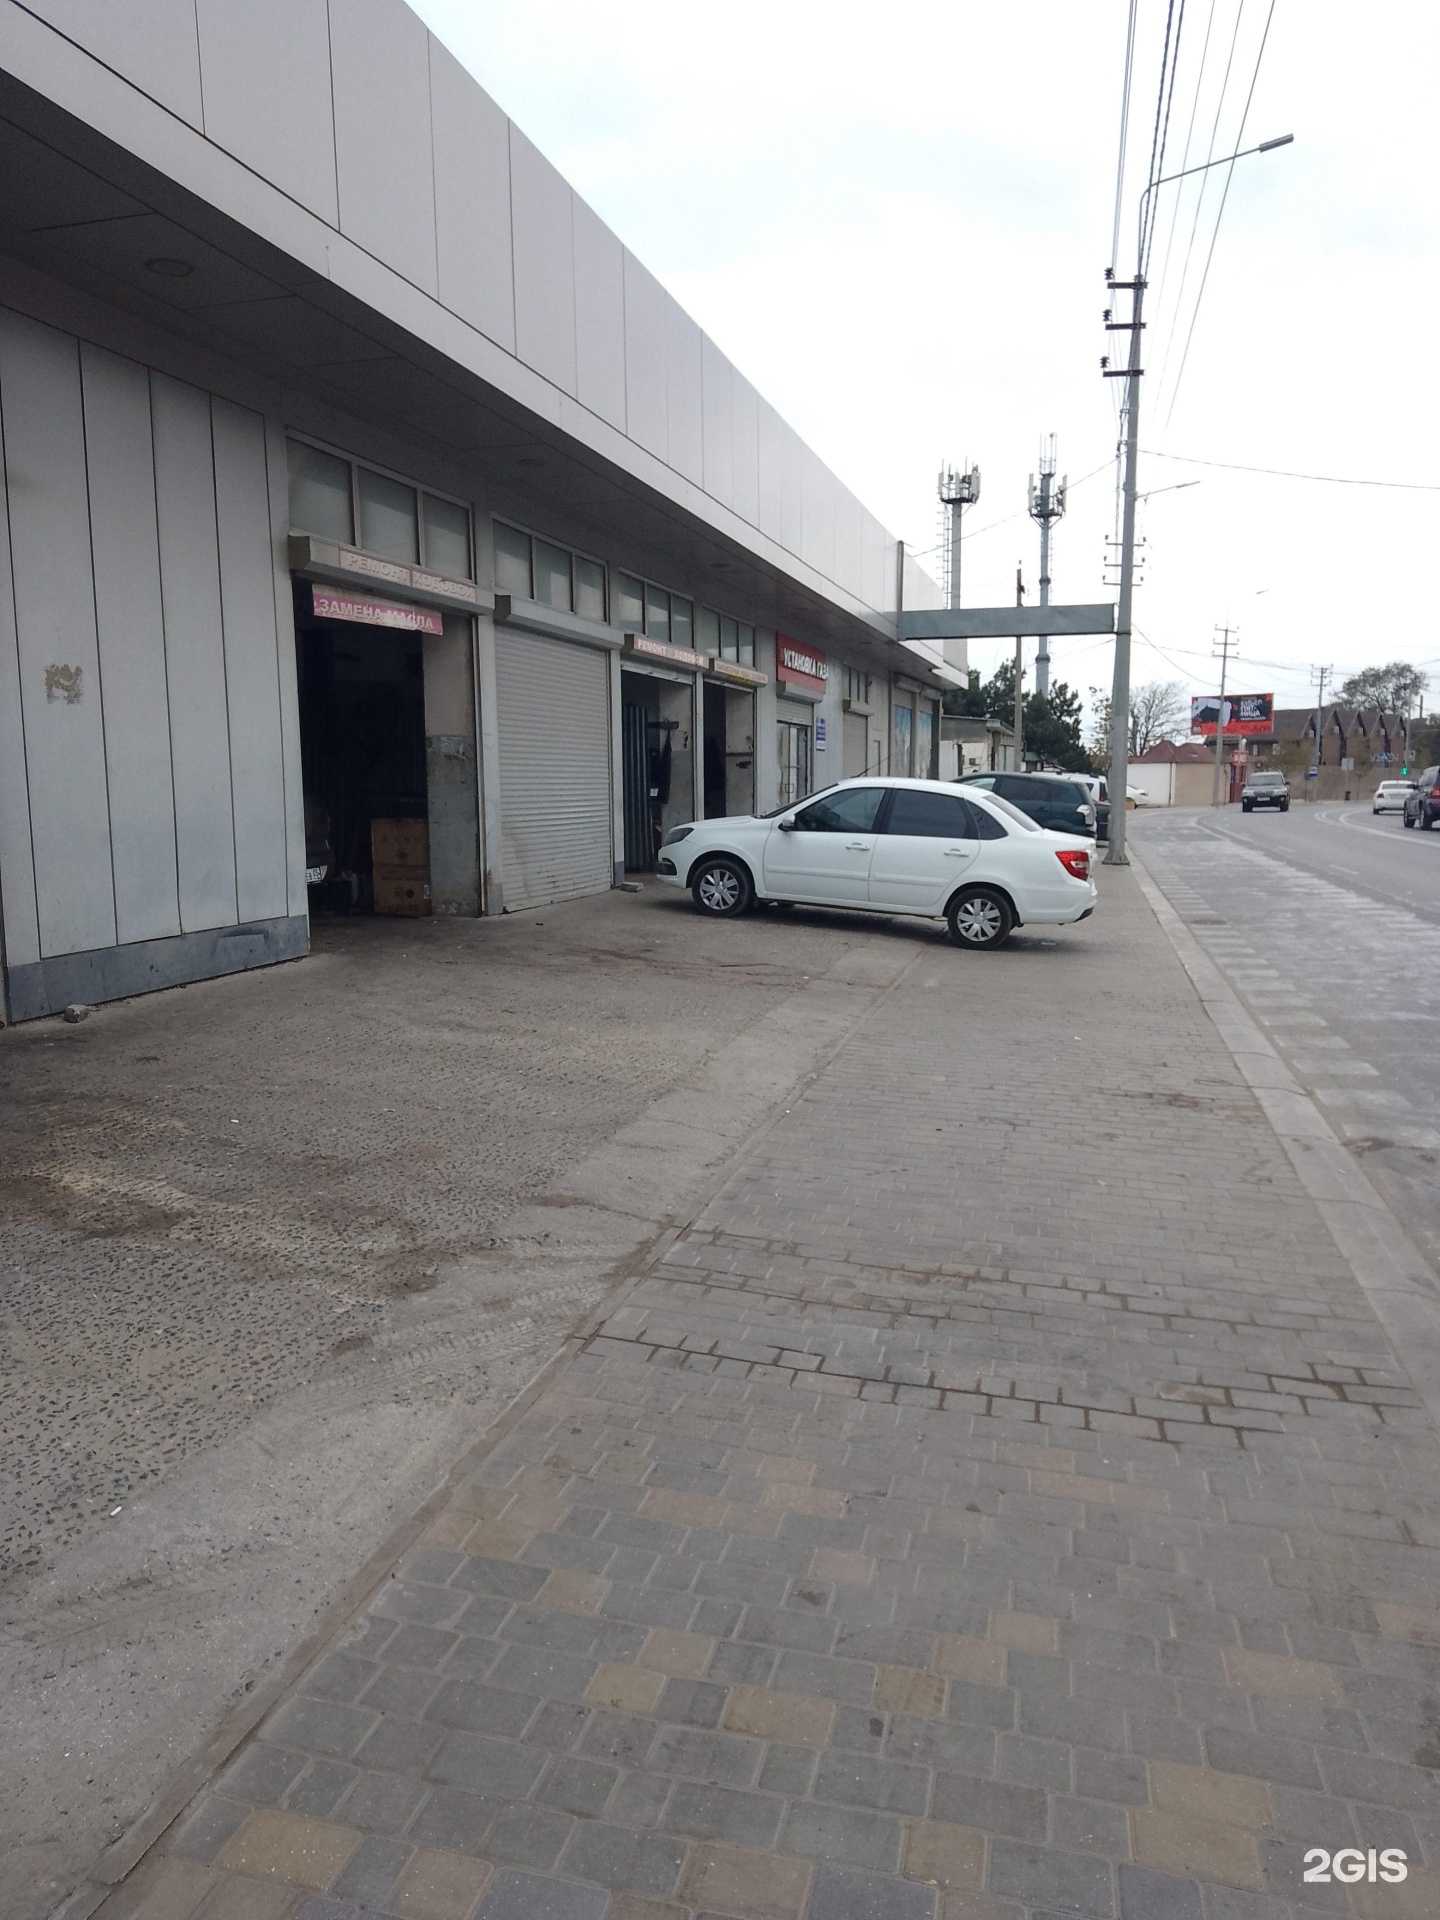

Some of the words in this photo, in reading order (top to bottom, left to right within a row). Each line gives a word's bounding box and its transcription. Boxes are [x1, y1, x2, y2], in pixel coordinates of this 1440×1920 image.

[319, 599, 381, 620] ЗАМЕНА
[386, 609, 434, 630] МАСЛА
[783, 647, 816, 677] УСТАНОВКА
